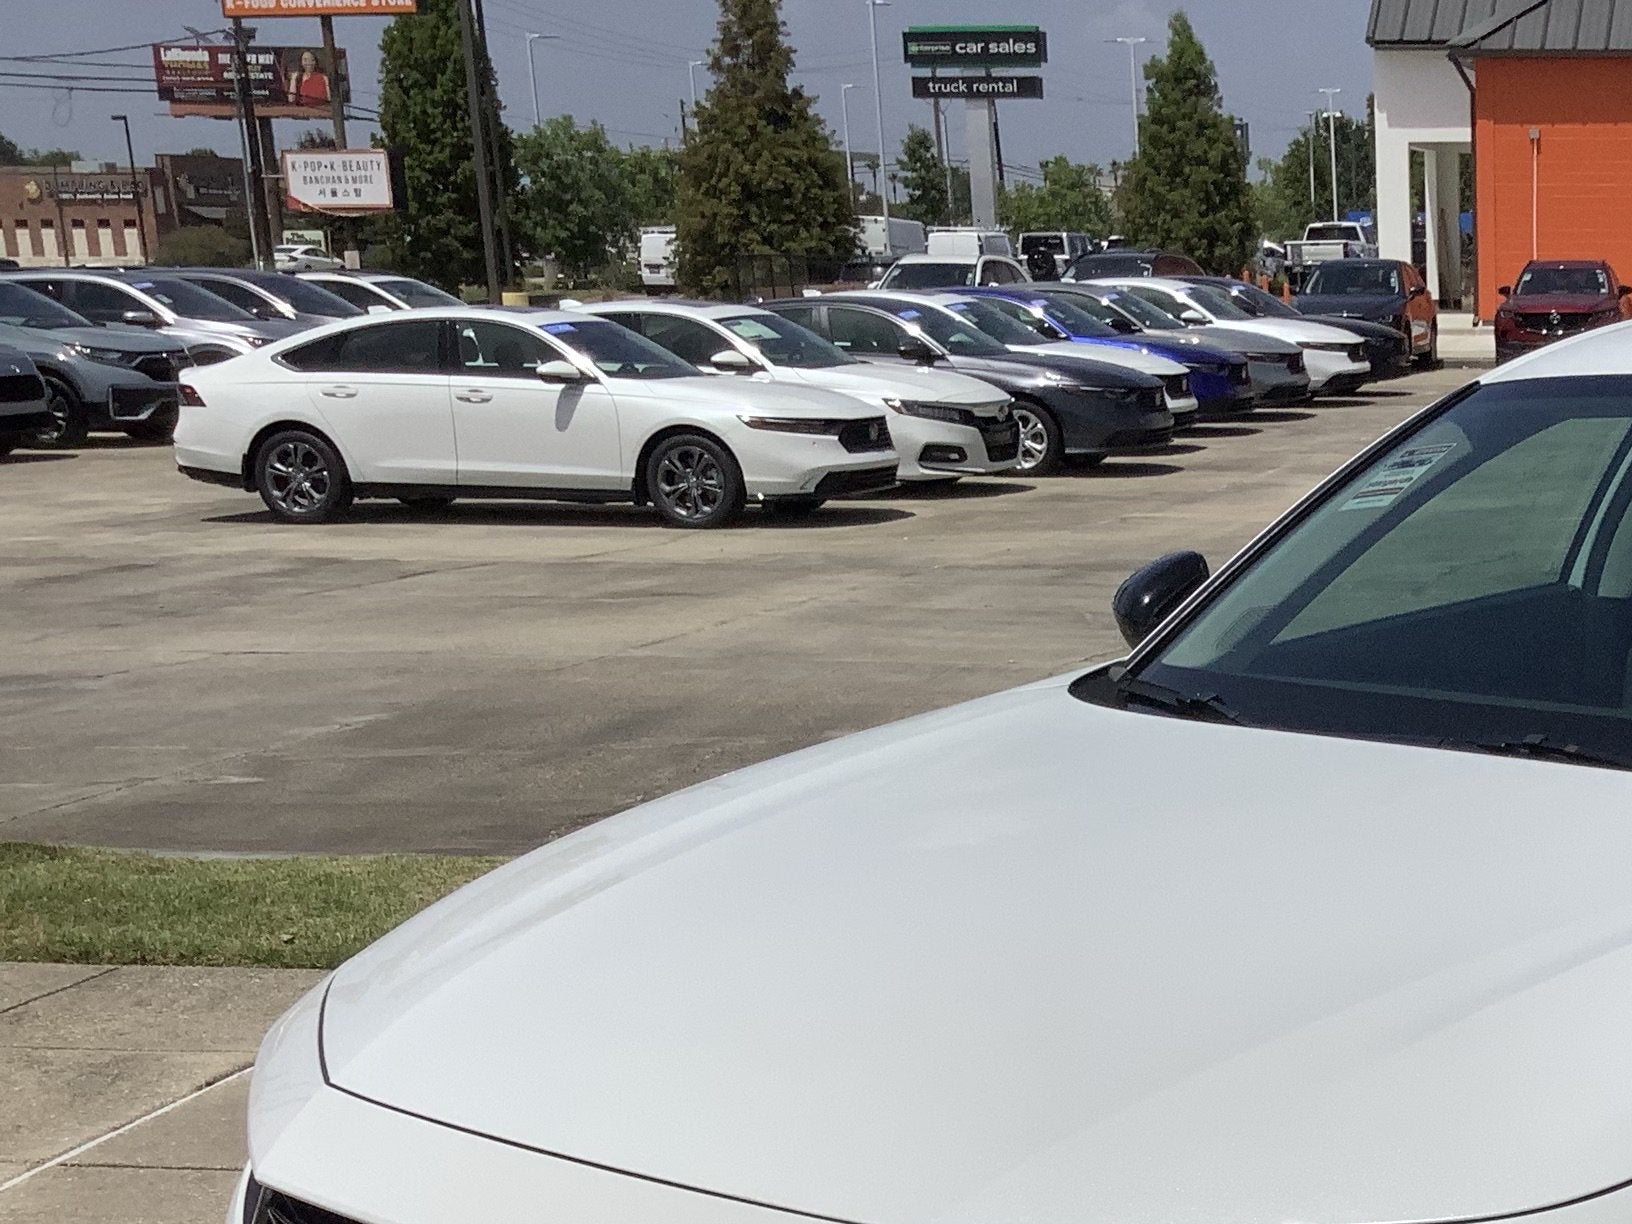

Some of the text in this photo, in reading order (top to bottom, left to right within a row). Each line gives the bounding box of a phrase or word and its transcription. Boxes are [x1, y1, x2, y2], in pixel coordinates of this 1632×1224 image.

[955, 42, 984, 53] car
[988, 38, 1036, 54] sales
[928, 79, 1018, 92] truck rental
